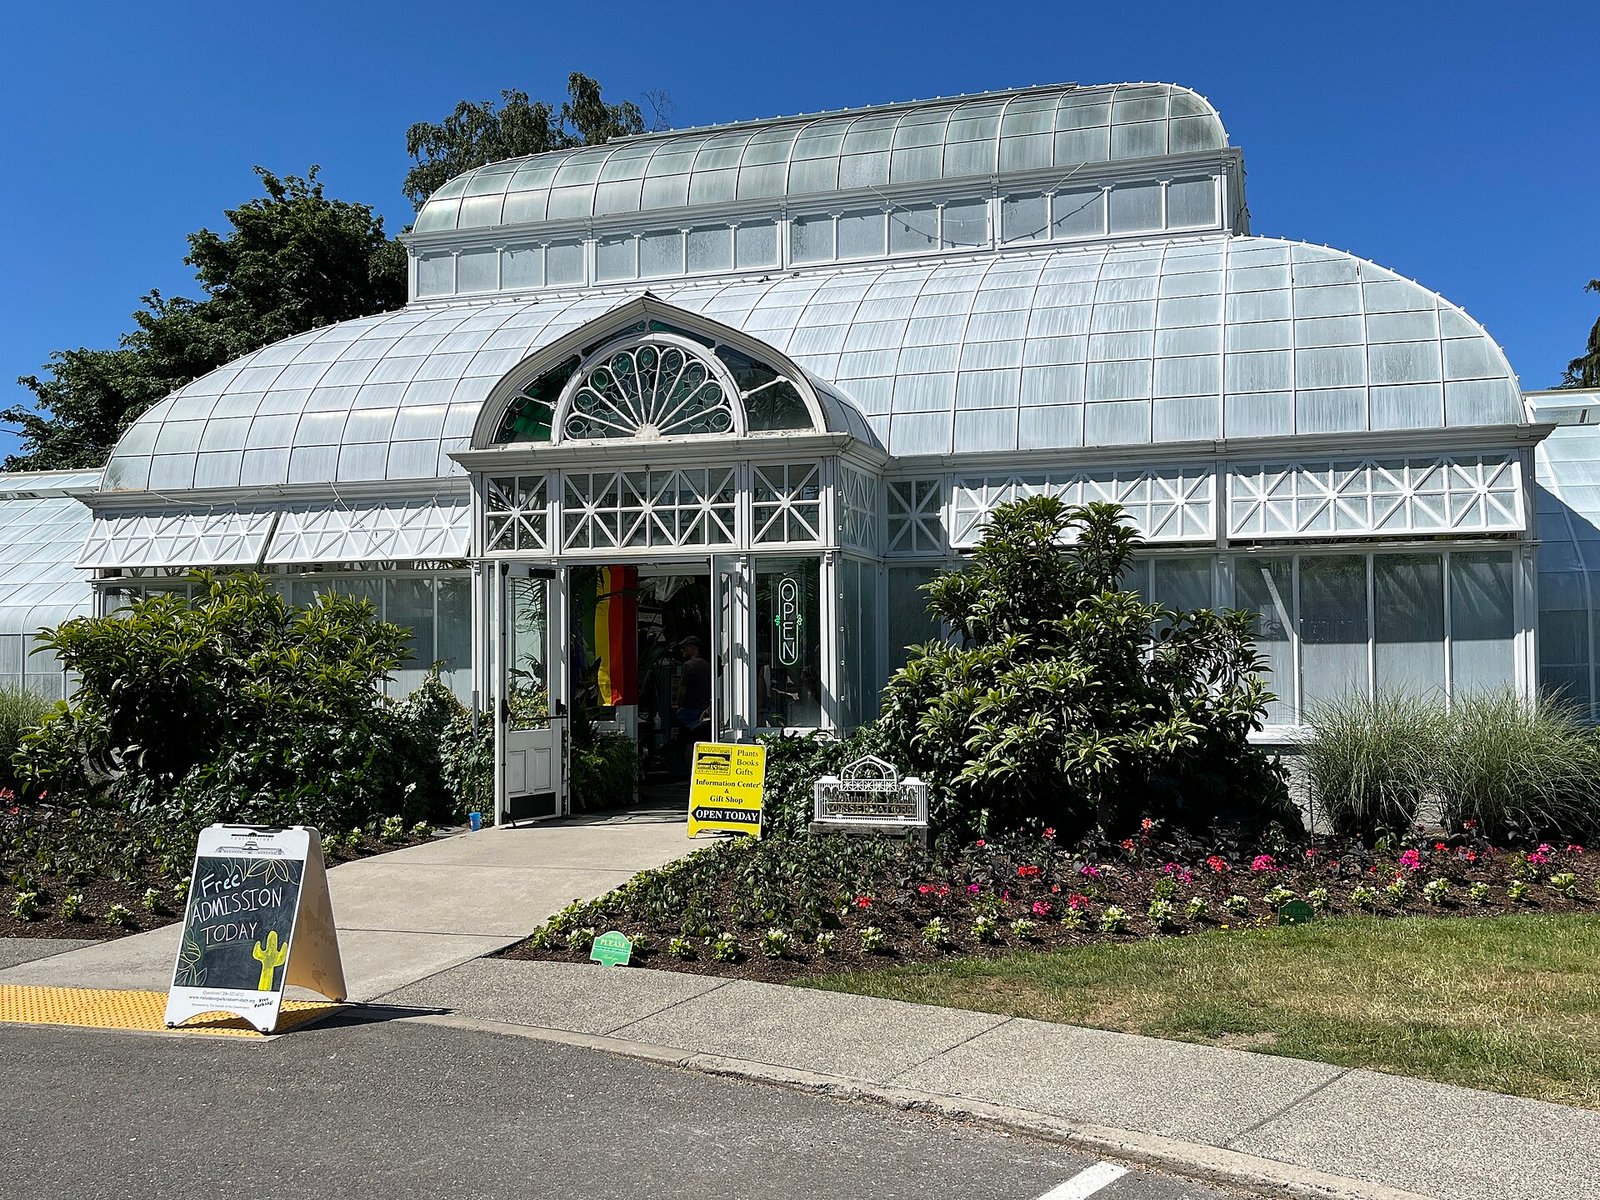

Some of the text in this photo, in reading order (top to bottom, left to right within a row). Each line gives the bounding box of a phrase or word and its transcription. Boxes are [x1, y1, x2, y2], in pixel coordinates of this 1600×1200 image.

[781, 583, 795, 660] OPEN
[737, 749, 759, 757] Plants
[735, 768, 754, 776] Gifts
[696, 778, 736, 787] Information
[725, 796, 744, 804] Shop
[695, 809, 758, 821] OPEN TODAY
[201, 873, 241, 898] Free
[191, 886, 282, 926] ADMISSION
[200, 922, 258, 945] TODAY
